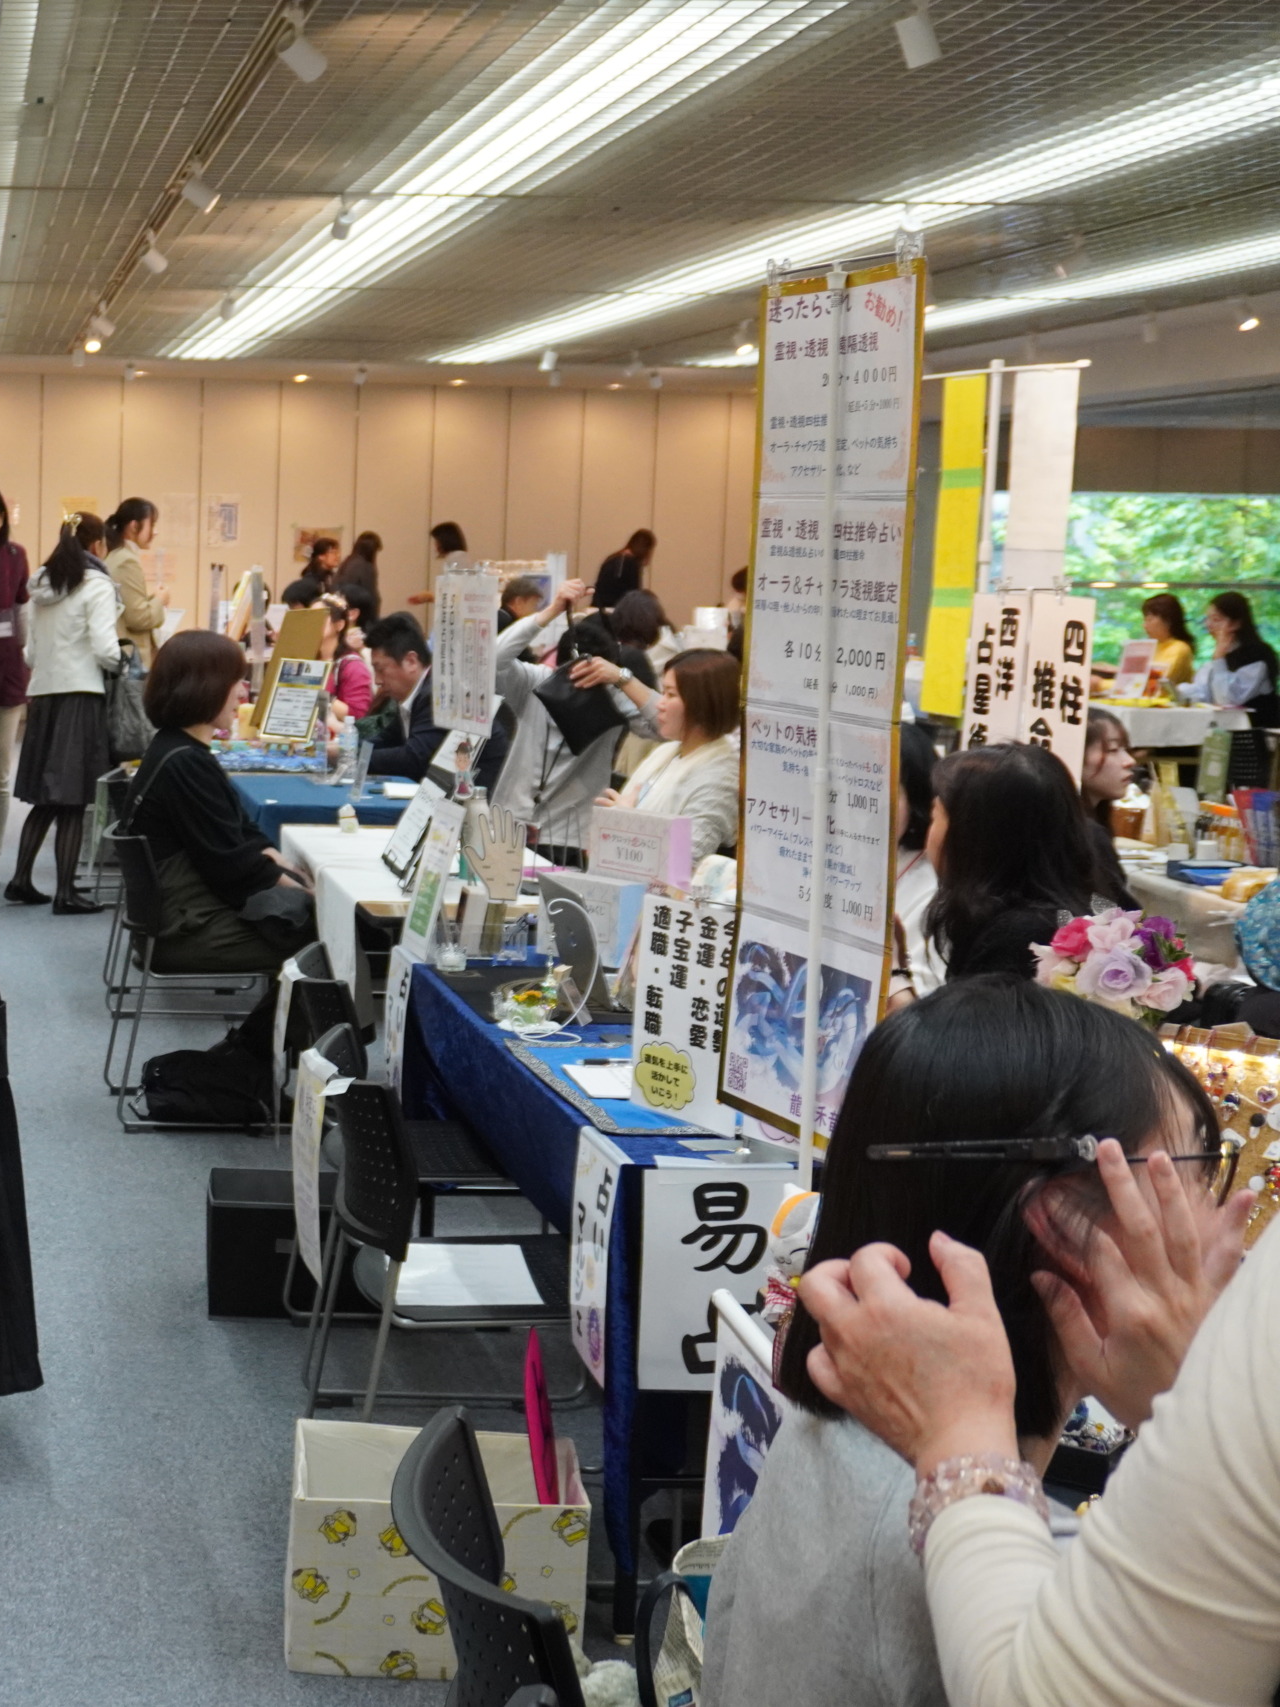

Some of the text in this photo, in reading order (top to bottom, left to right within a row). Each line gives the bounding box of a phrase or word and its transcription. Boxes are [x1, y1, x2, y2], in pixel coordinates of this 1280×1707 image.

[836, 647, 886, 671] 2,000円
[1060, 619, 1088, 725] 四柱
[751, 719, 818, 749] ペットの気持
[670, 910, 695, 990] 子宝運
